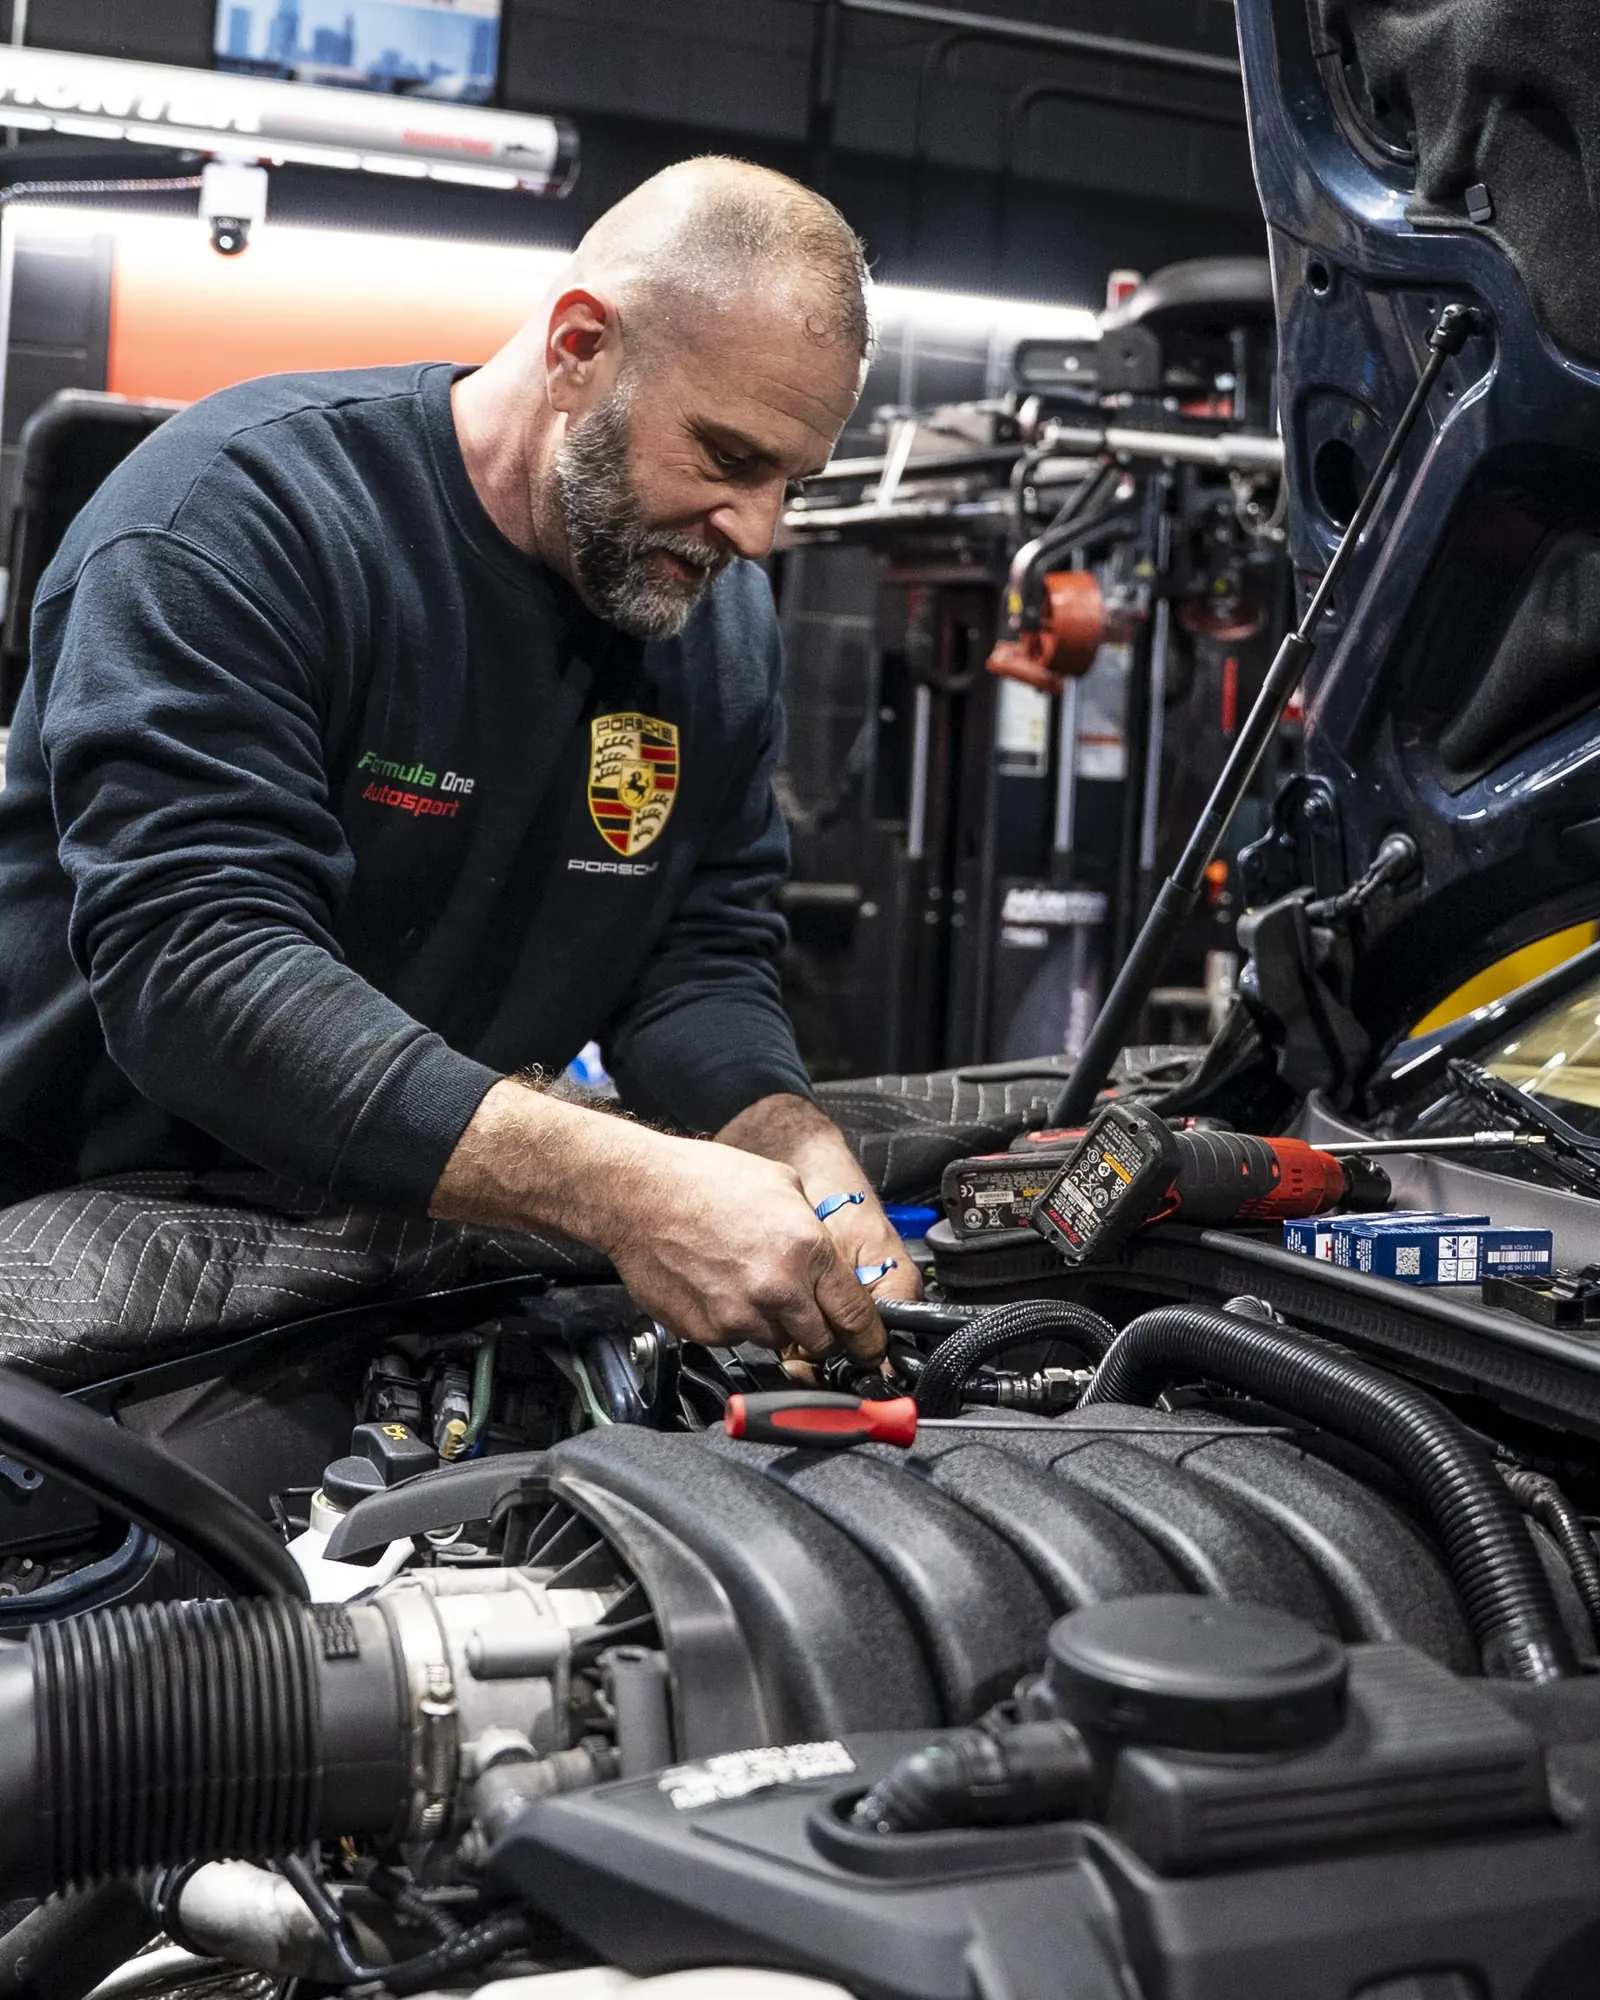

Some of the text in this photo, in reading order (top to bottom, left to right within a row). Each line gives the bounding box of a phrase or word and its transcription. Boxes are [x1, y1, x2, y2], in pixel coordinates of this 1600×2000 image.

[357, 751, 475, 794] Formula One
[362, 781, 460, 818] Autosport
